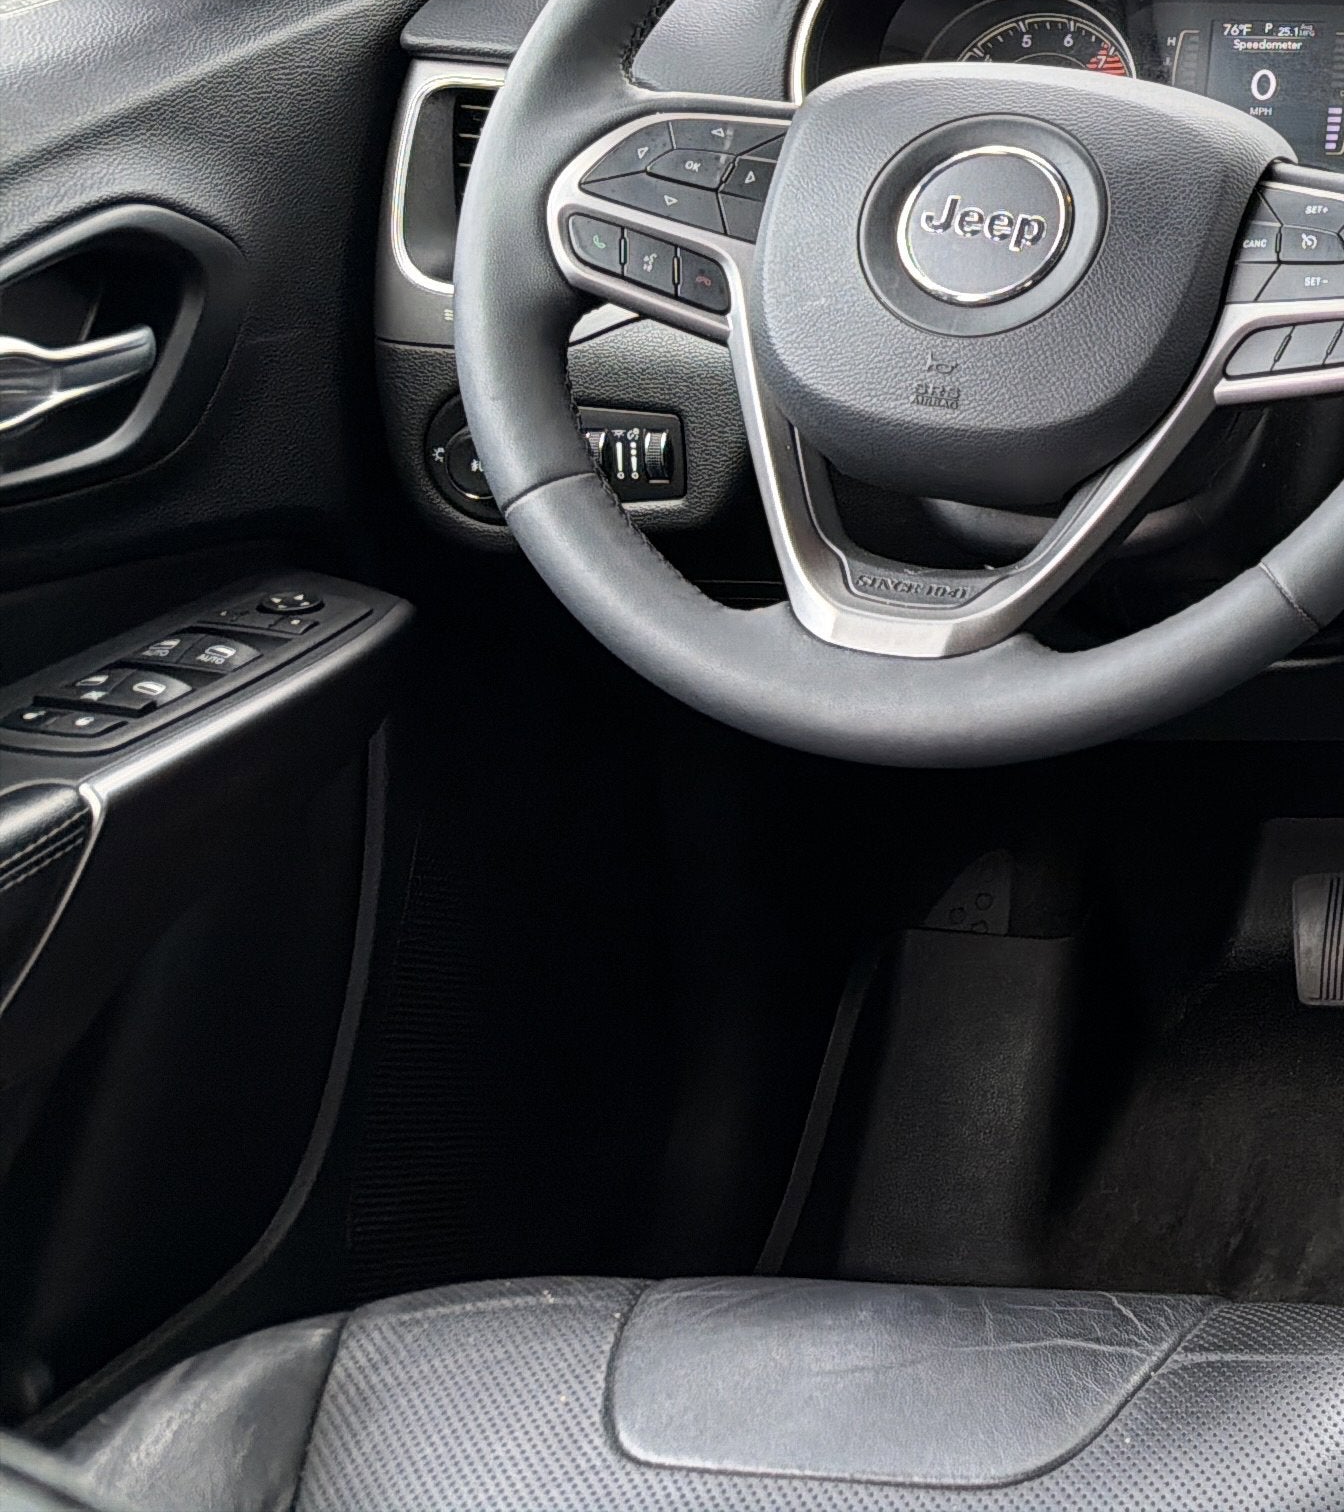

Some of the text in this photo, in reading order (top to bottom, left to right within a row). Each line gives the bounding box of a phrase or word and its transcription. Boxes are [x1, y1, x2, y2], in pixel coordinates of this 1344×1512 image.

[1222, 23, 1253, 36] 76°F
[1264, 23, 1273, 34] P
[1021, 34, 1032, 48] 5
[1063, 34, 1074, 48] 6
[1166, 37, 1176, 47] H
[1233, 39, 1302, 51] Speedometer
[1096, 55, 1107, 69] 7
[1250, 68, 1278, 102] 0
[1250, 106, 1273, 116] MPH
[684, 160, 701, 172] OK
[920, 194, 1048, 253] Jeep
[1243, 238, 1267, 249] CANC
[856, 574, 921, 595] SINCE
[196, 653, 225, 665] AUTO
